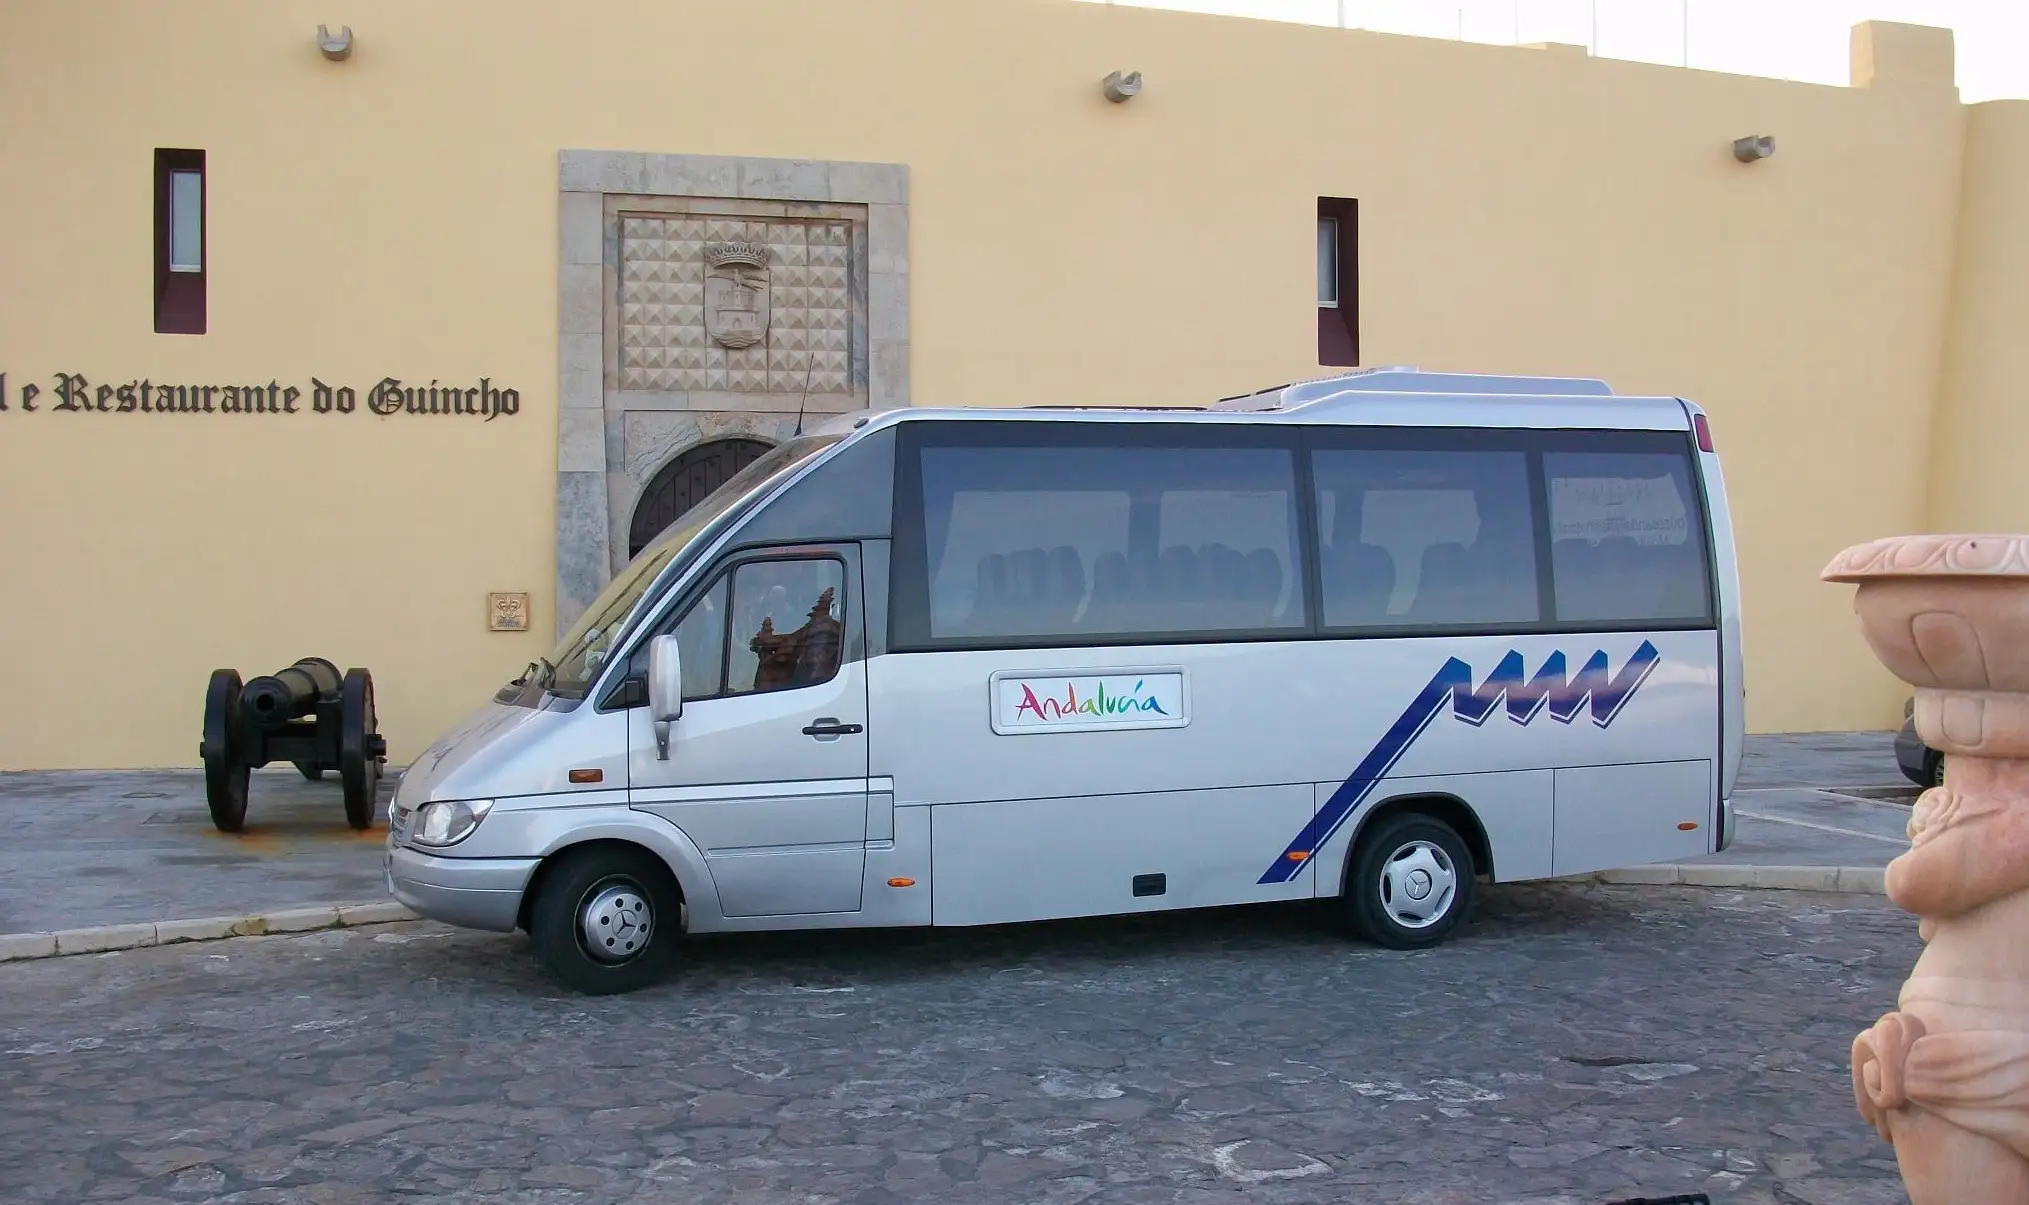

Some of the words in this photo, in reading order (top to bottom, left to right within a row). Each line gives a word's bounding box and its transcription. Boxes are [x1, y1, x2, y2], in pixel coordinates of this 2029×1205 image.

[21, 383, 41, 413] e
[52, 372, 301, 414] Restaurante
[311, 376, 356, 414] do
[367, 377, 520, 423] Guincho
[1015, 677, 1169, 722] Andalucía
